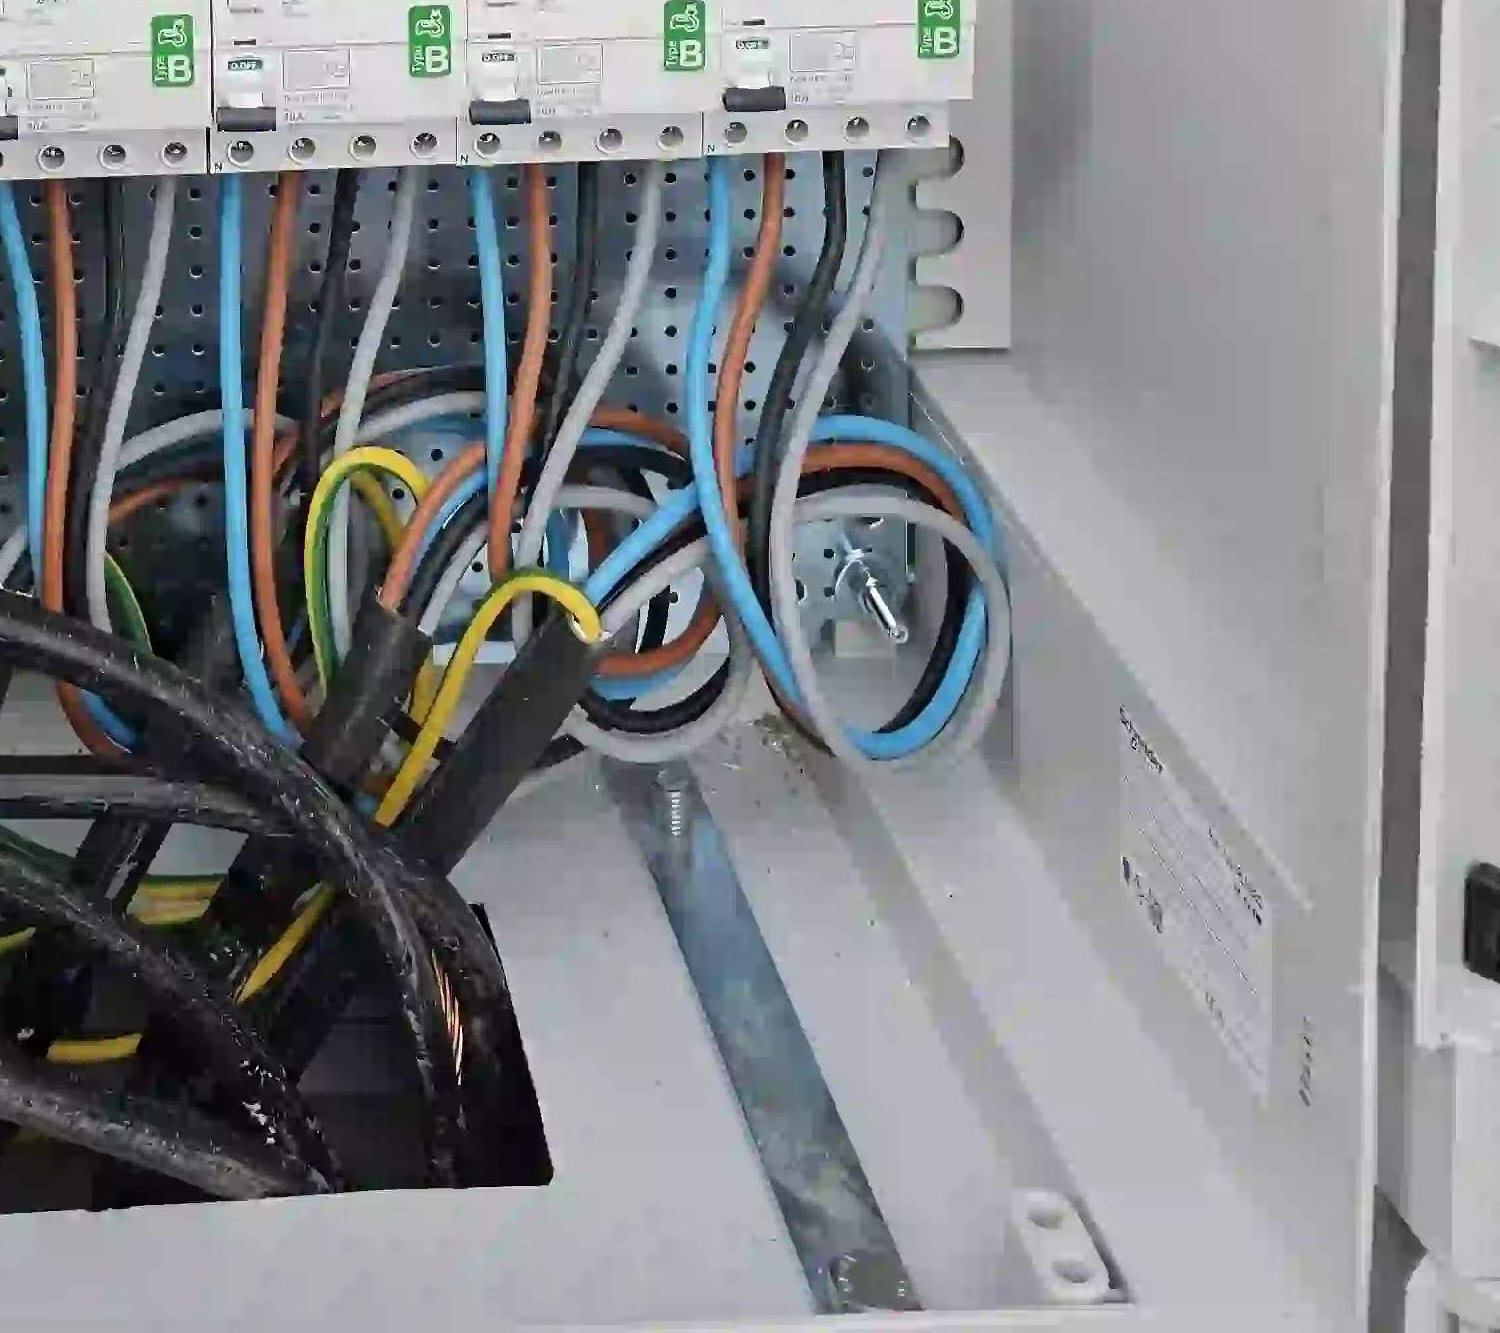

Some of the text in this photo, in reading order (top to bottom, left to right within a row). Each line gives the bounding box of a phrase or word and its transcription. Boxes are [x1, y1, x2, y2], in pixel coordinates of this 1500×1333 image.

[665, 39, 703, 67] Type B
[933, 26, 957, 55] B
[168, 55, 192, 83] B
[425, 45, 449, 73] B
